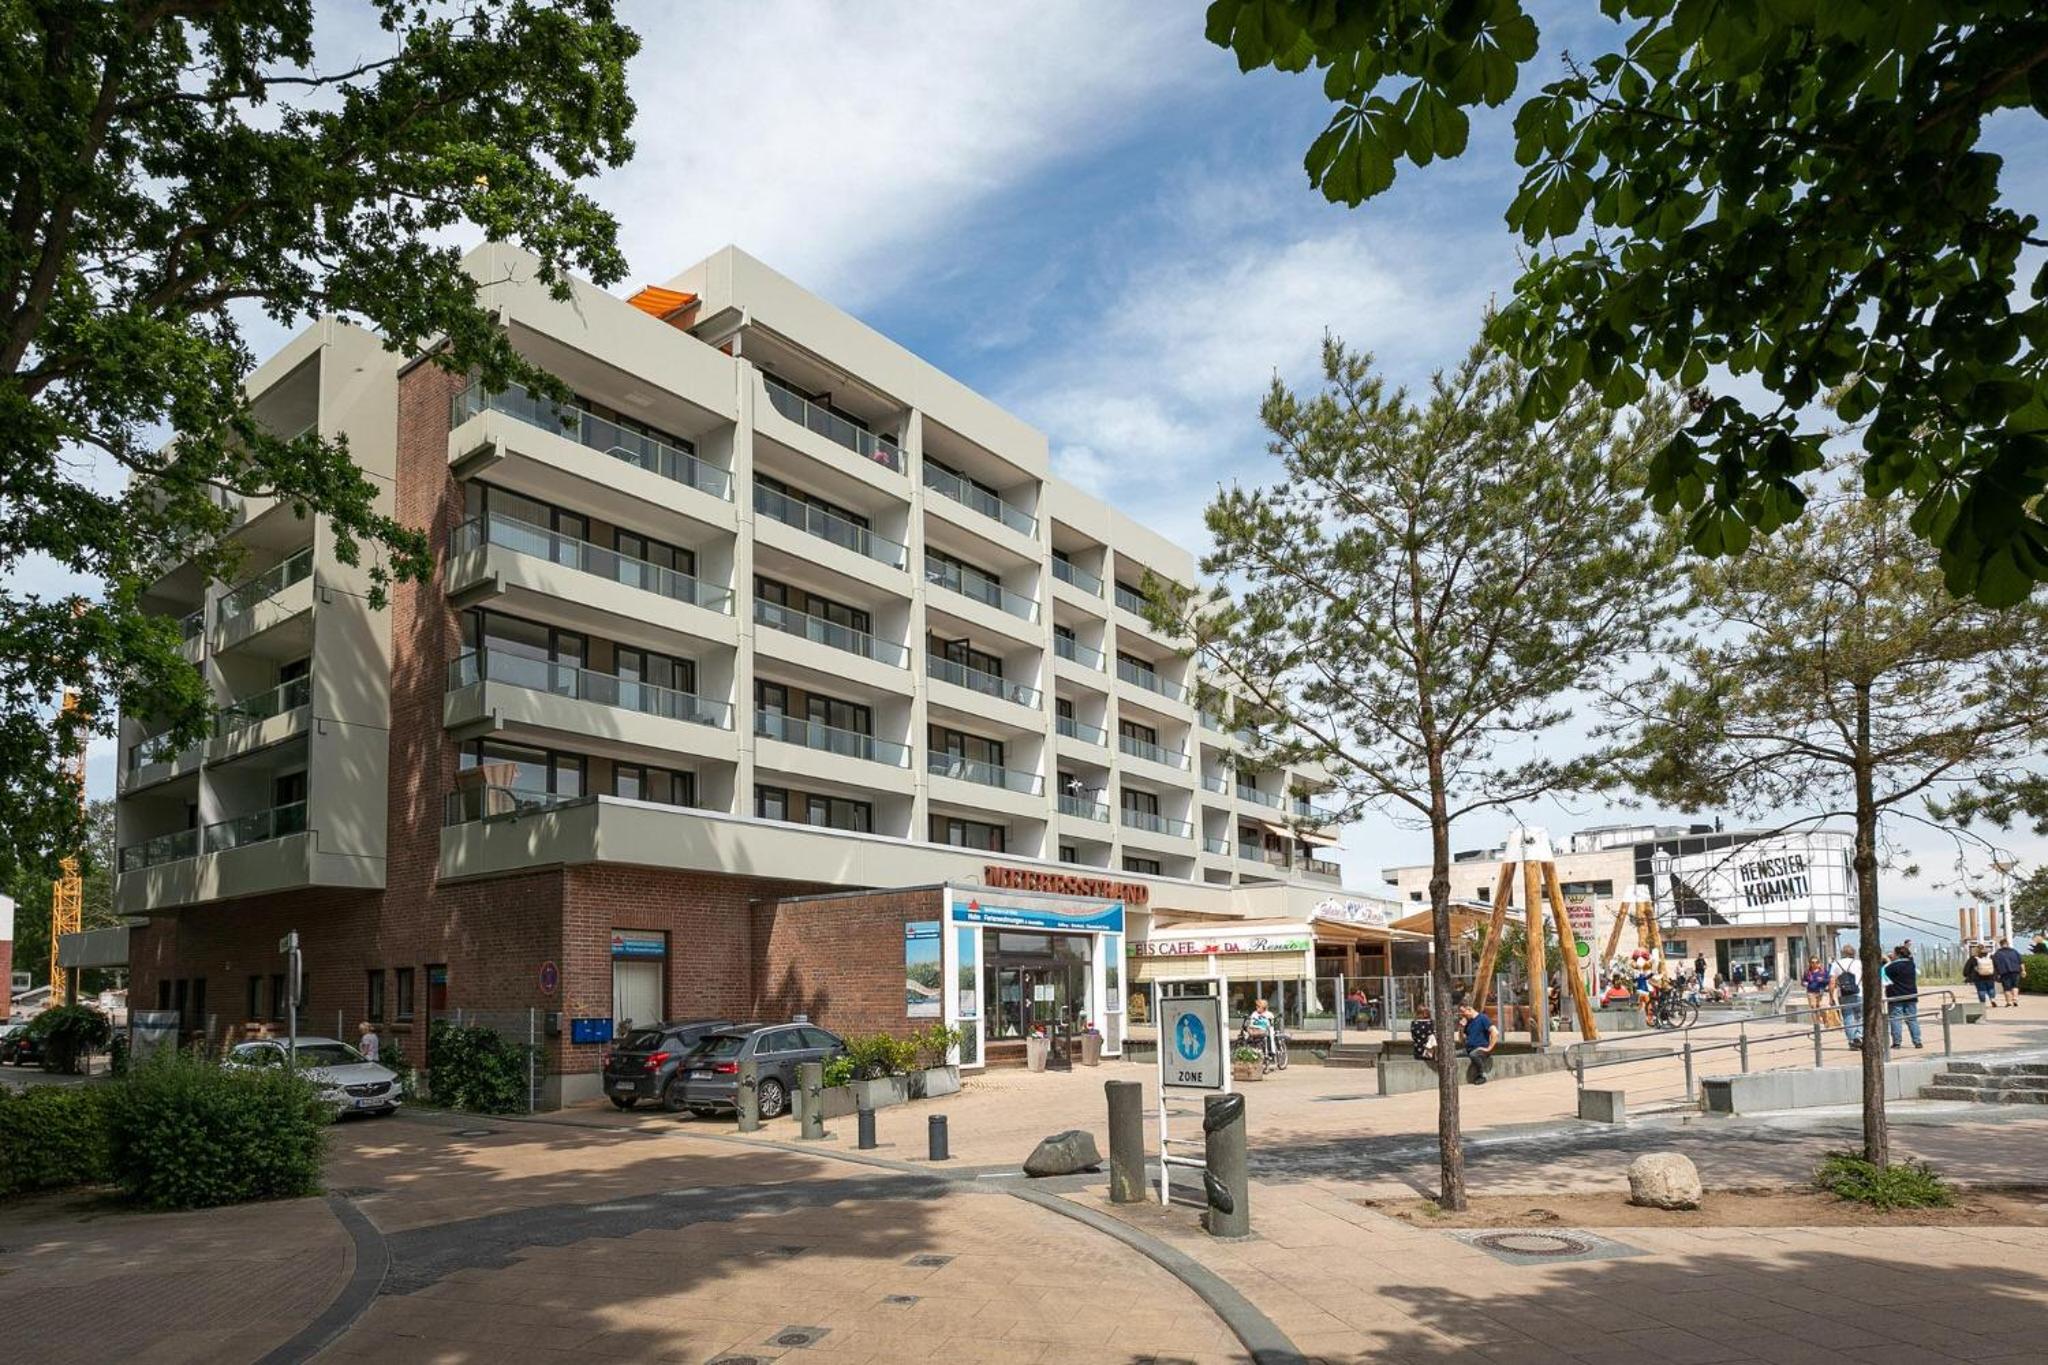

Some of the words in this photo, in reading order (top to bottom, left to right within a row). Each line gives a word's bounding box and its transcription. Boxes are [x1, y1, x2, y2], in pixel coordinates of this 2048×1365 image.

[1740, 854, 1805, 882] HENSSLER
[984, 866, 1149, 905] MEERESSTRAND
[1743, 875, 1810, 907] KOMMT!
[1135, 943, 1155, 956] EIS
[1179, 1071, 1203, 1082] ZONE
